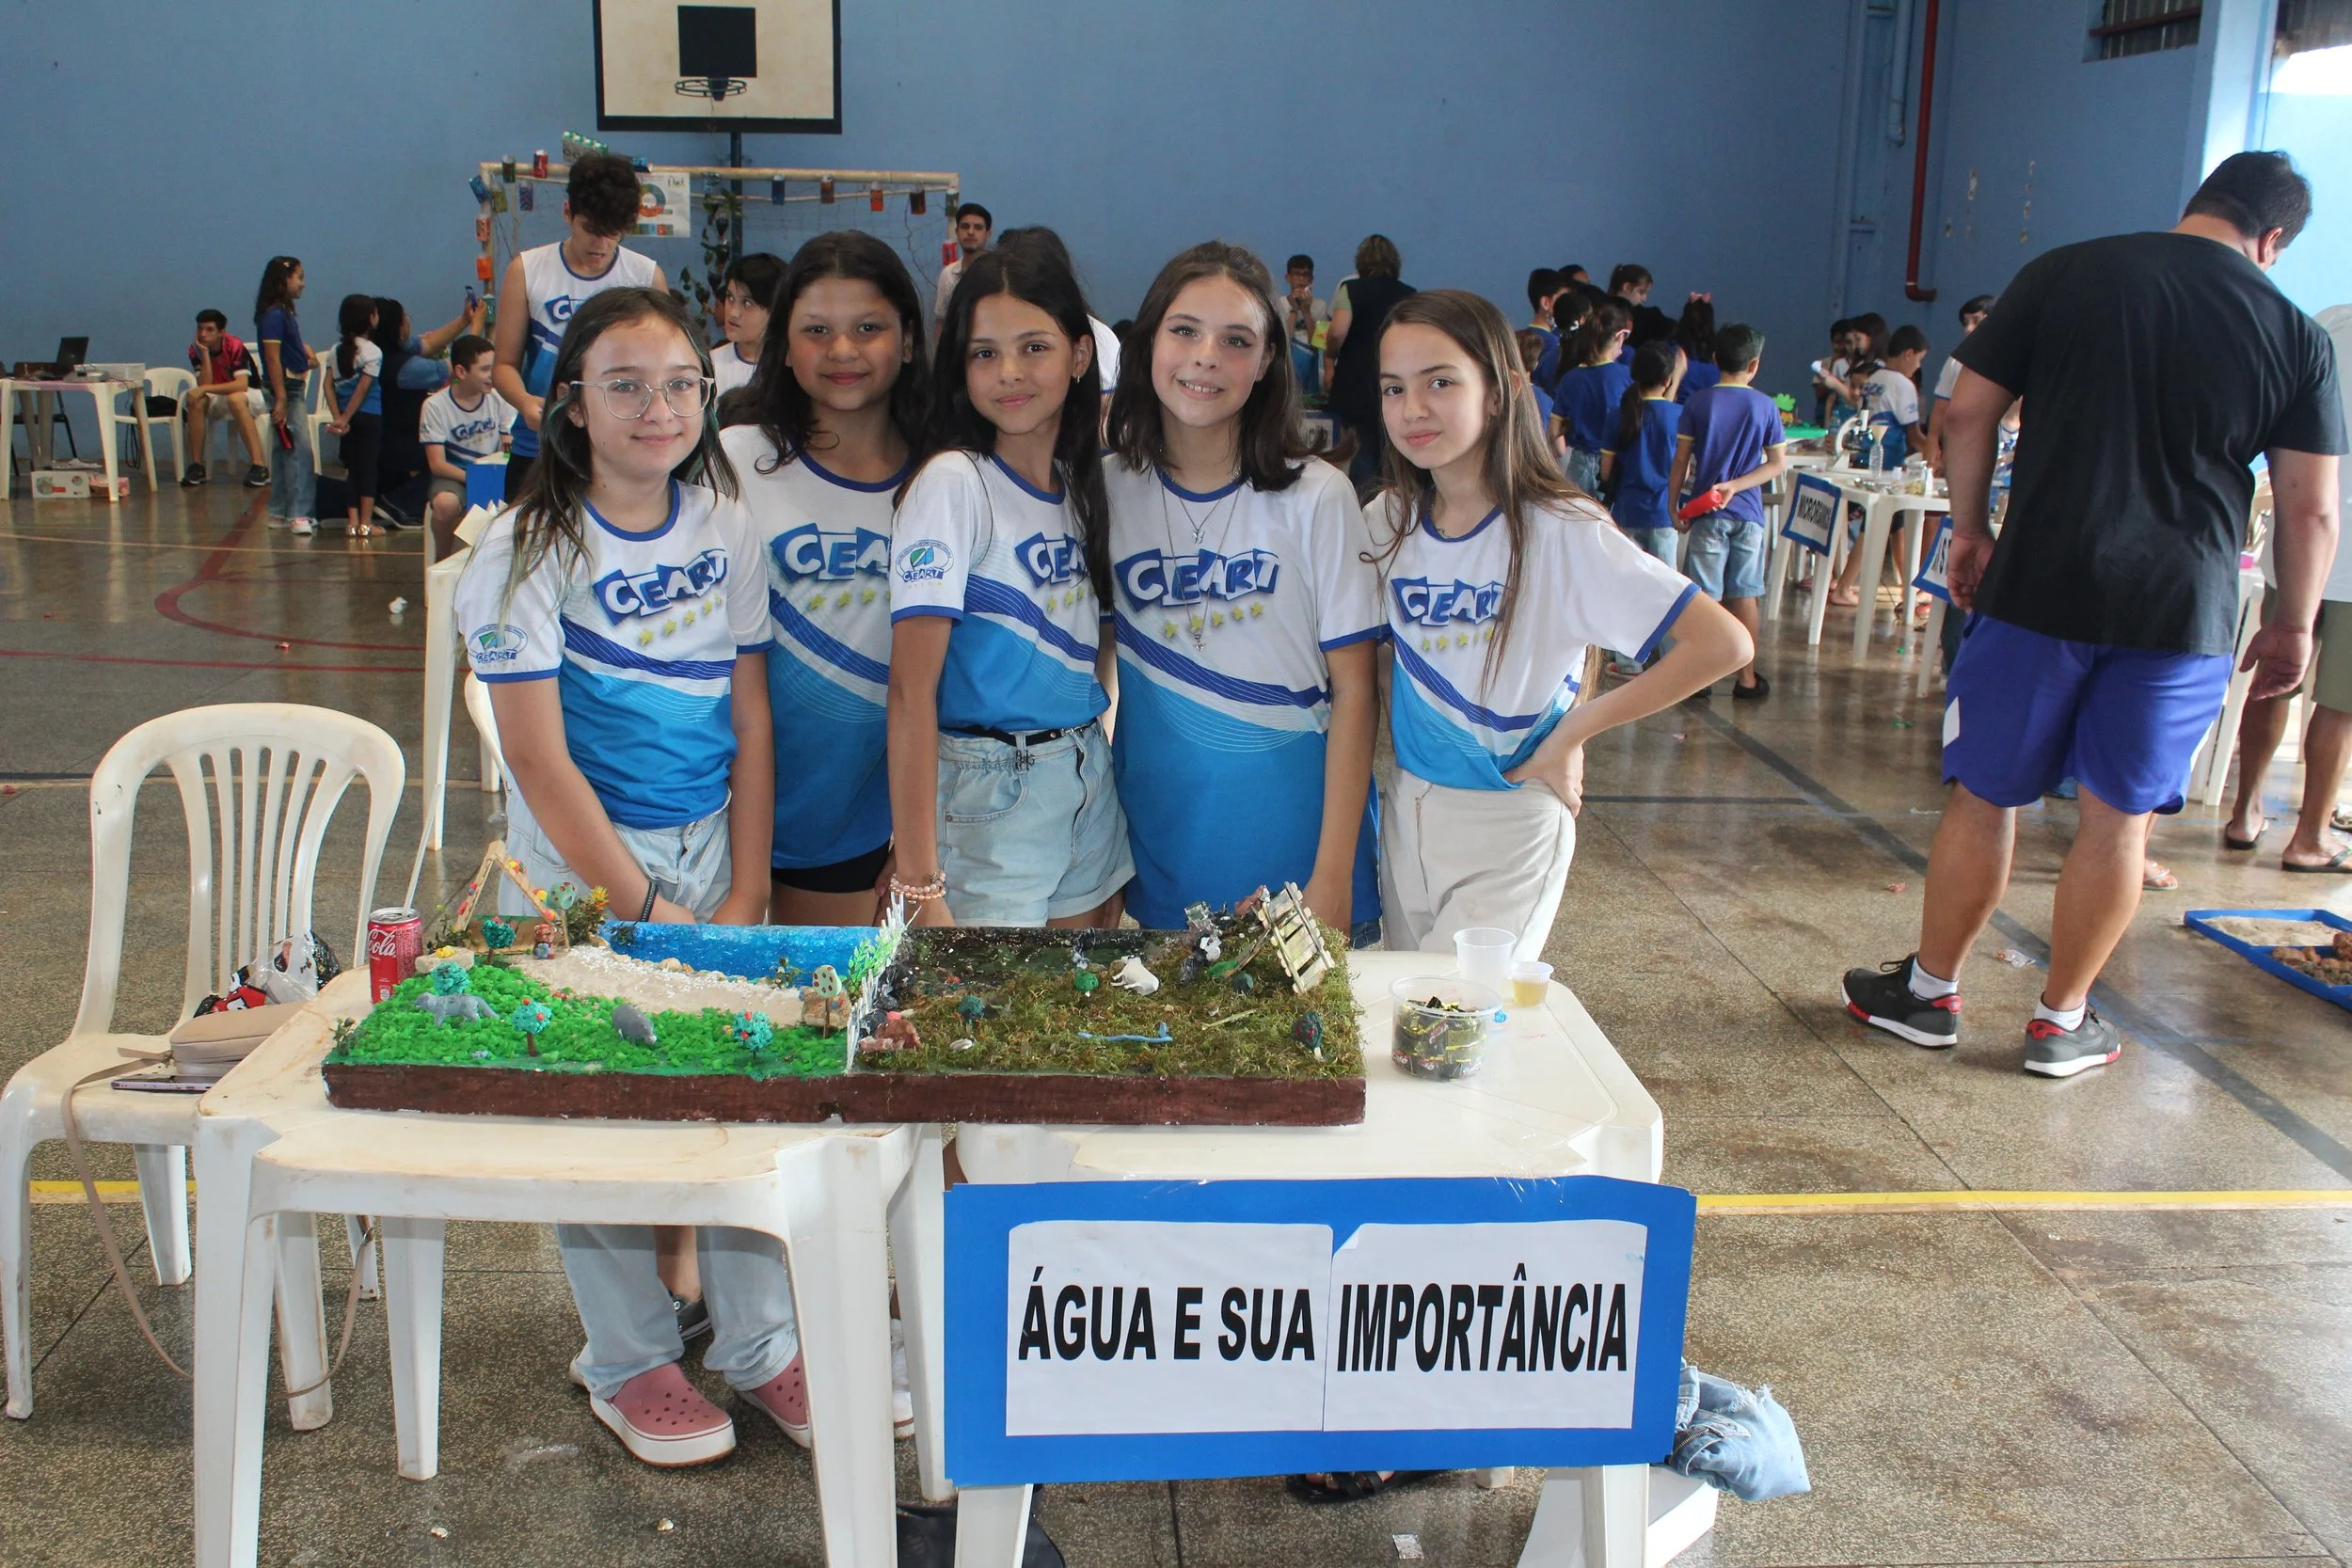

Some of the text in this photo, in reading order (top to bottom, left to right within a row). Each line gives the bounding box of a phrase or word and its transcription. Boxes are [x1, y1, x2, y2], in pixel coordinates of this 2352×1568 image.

[779, 528, 891, 579] CEA
[902, 567, 945, 582] CEART
[1022, 537, 1089, 582] CEA
[1121, 549, 1279, 606] CEART
[597, 549, 728, 619] CEART
[476, 649, 517, 663] CEART
[1018, 1262, 1628, 1372] ÁGUA E SUA IMPORTÂNCIA
